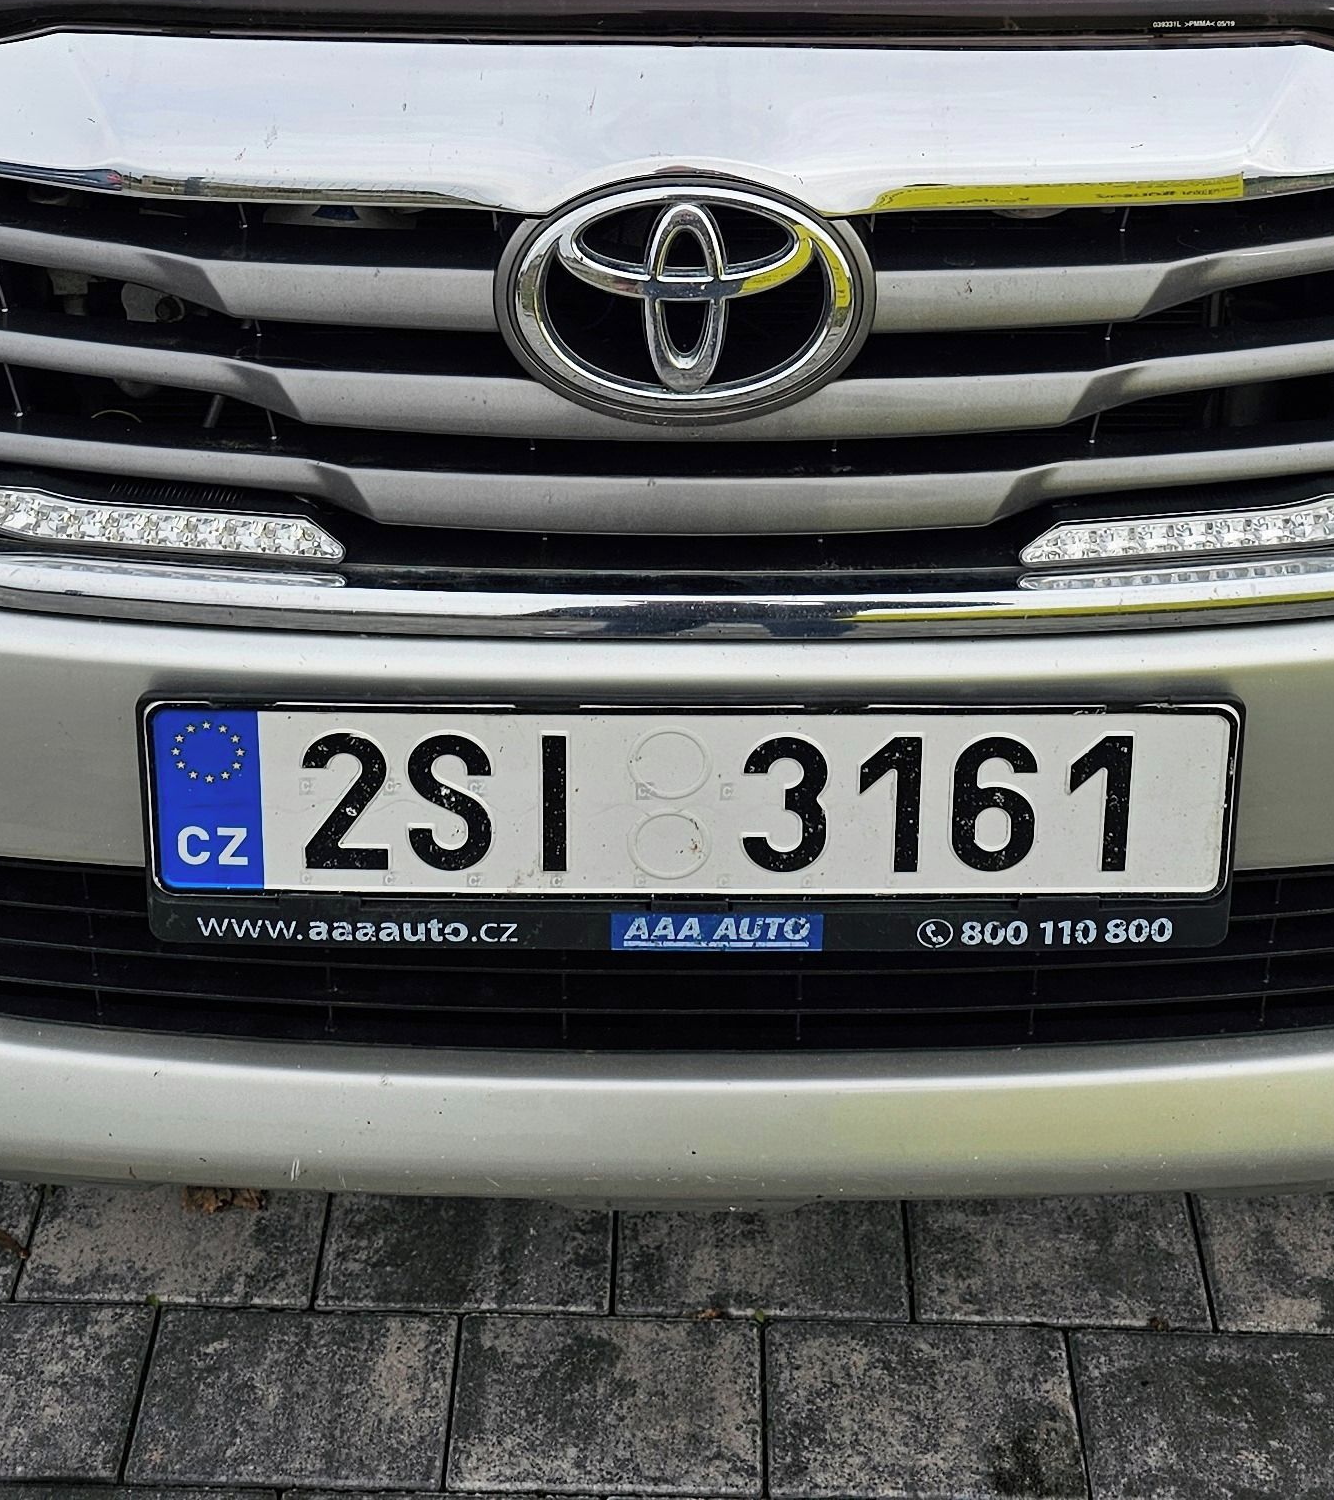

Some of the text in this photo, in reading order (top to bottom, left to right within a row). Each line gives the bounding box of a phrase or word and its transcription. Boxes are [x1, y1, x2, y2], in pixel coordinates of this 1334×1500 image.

[301, 732, 1134, 873] 2SI 3161
[176, 825, 250, 867] CZ
[197, 916, 519, 943] www.aaaauto.cz
[623, 916, 811, 940] AAA AUTO
[960, 917, 1174, 945] 800 110 800
